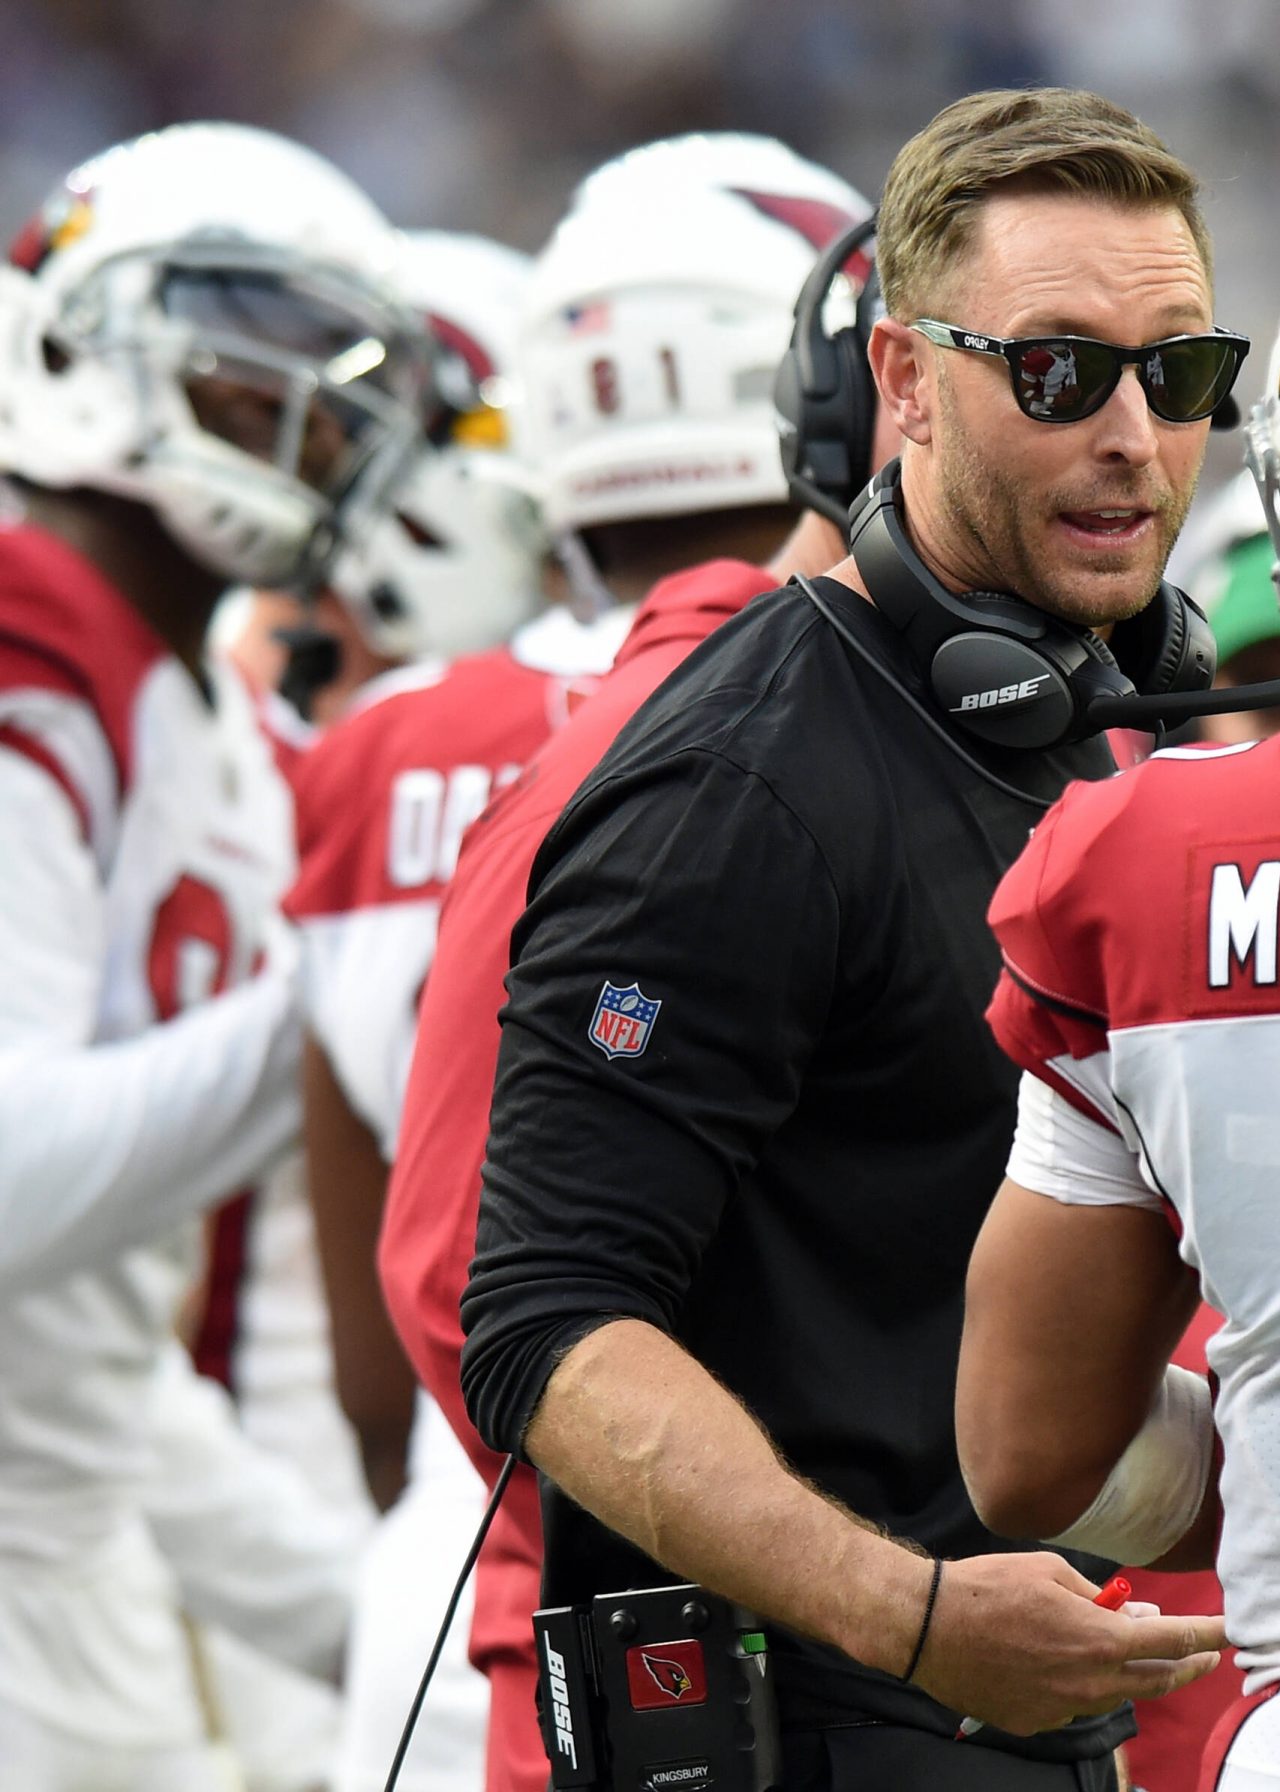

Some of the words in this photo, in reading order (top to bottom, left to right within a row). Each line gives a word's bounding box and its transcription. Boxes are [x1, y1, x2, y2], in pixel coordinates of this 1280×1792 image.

[964, 335, 989, 350] OAKLEY
[949, 674, 1050, 712] BOSE
[595, 1009, 640, 1050] NFL
[544, 1630, 577, 1770] BOSE
[652, 1765, 708, 1784] KINGSBURY
